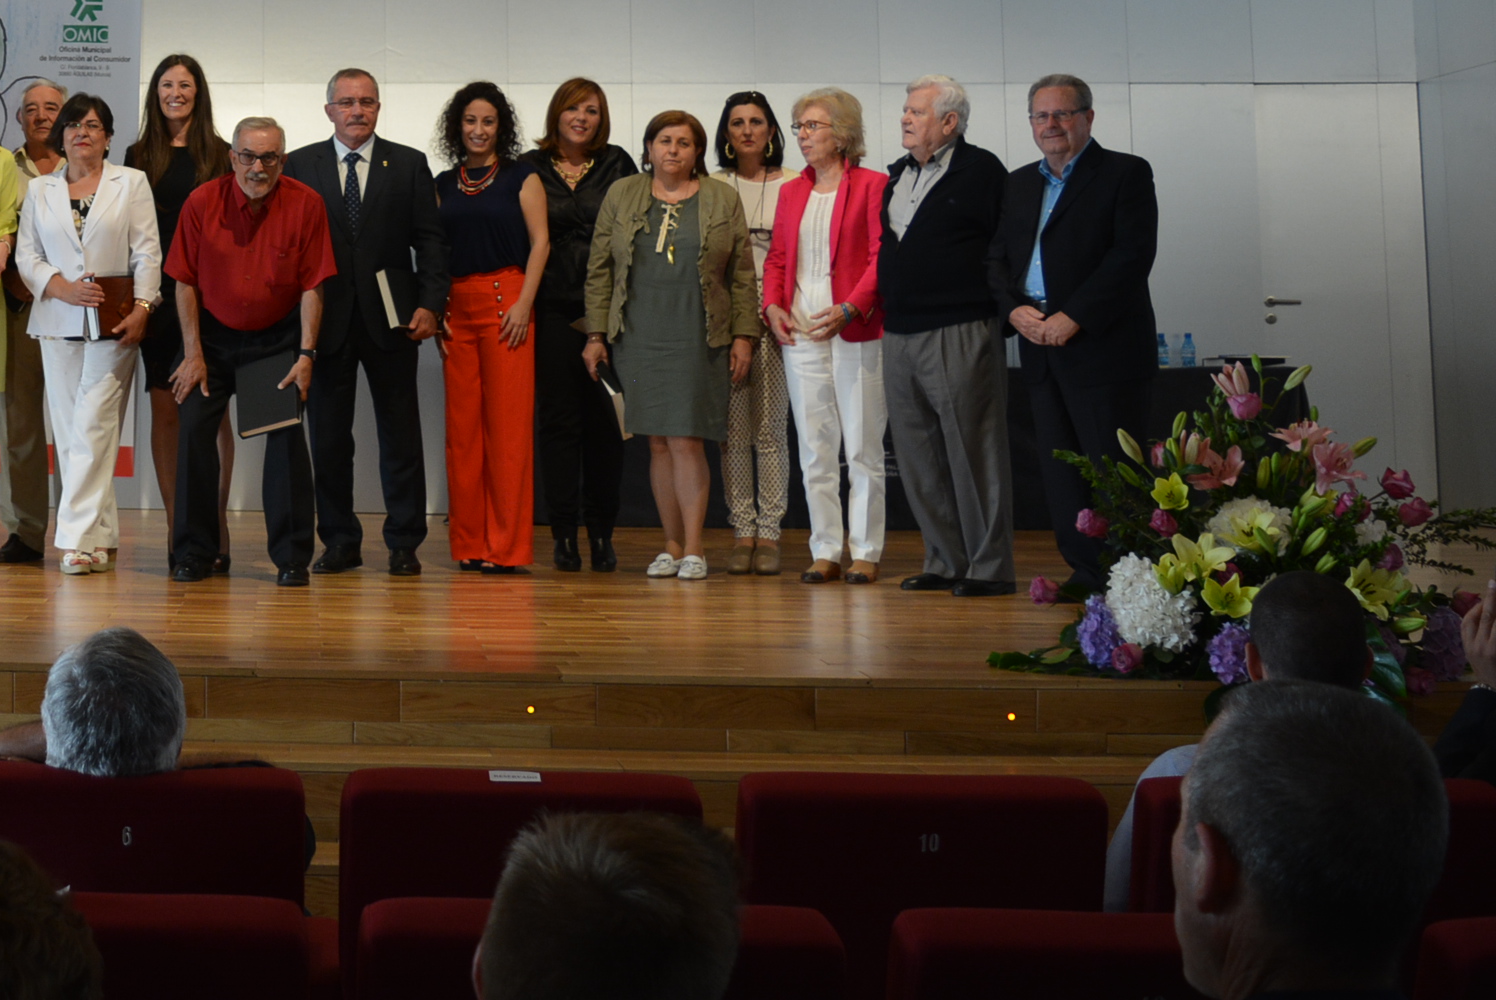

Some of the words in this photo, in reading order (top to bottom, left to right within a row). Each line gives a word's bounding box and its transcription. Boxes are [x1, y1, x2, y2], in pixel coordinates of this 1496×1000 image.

[64, 26, 109, 43] OMIC
[82, 46, 112, 54] Municipal
[122, 825, 133, 846] 6
[917, 833, 940, 853] 10
